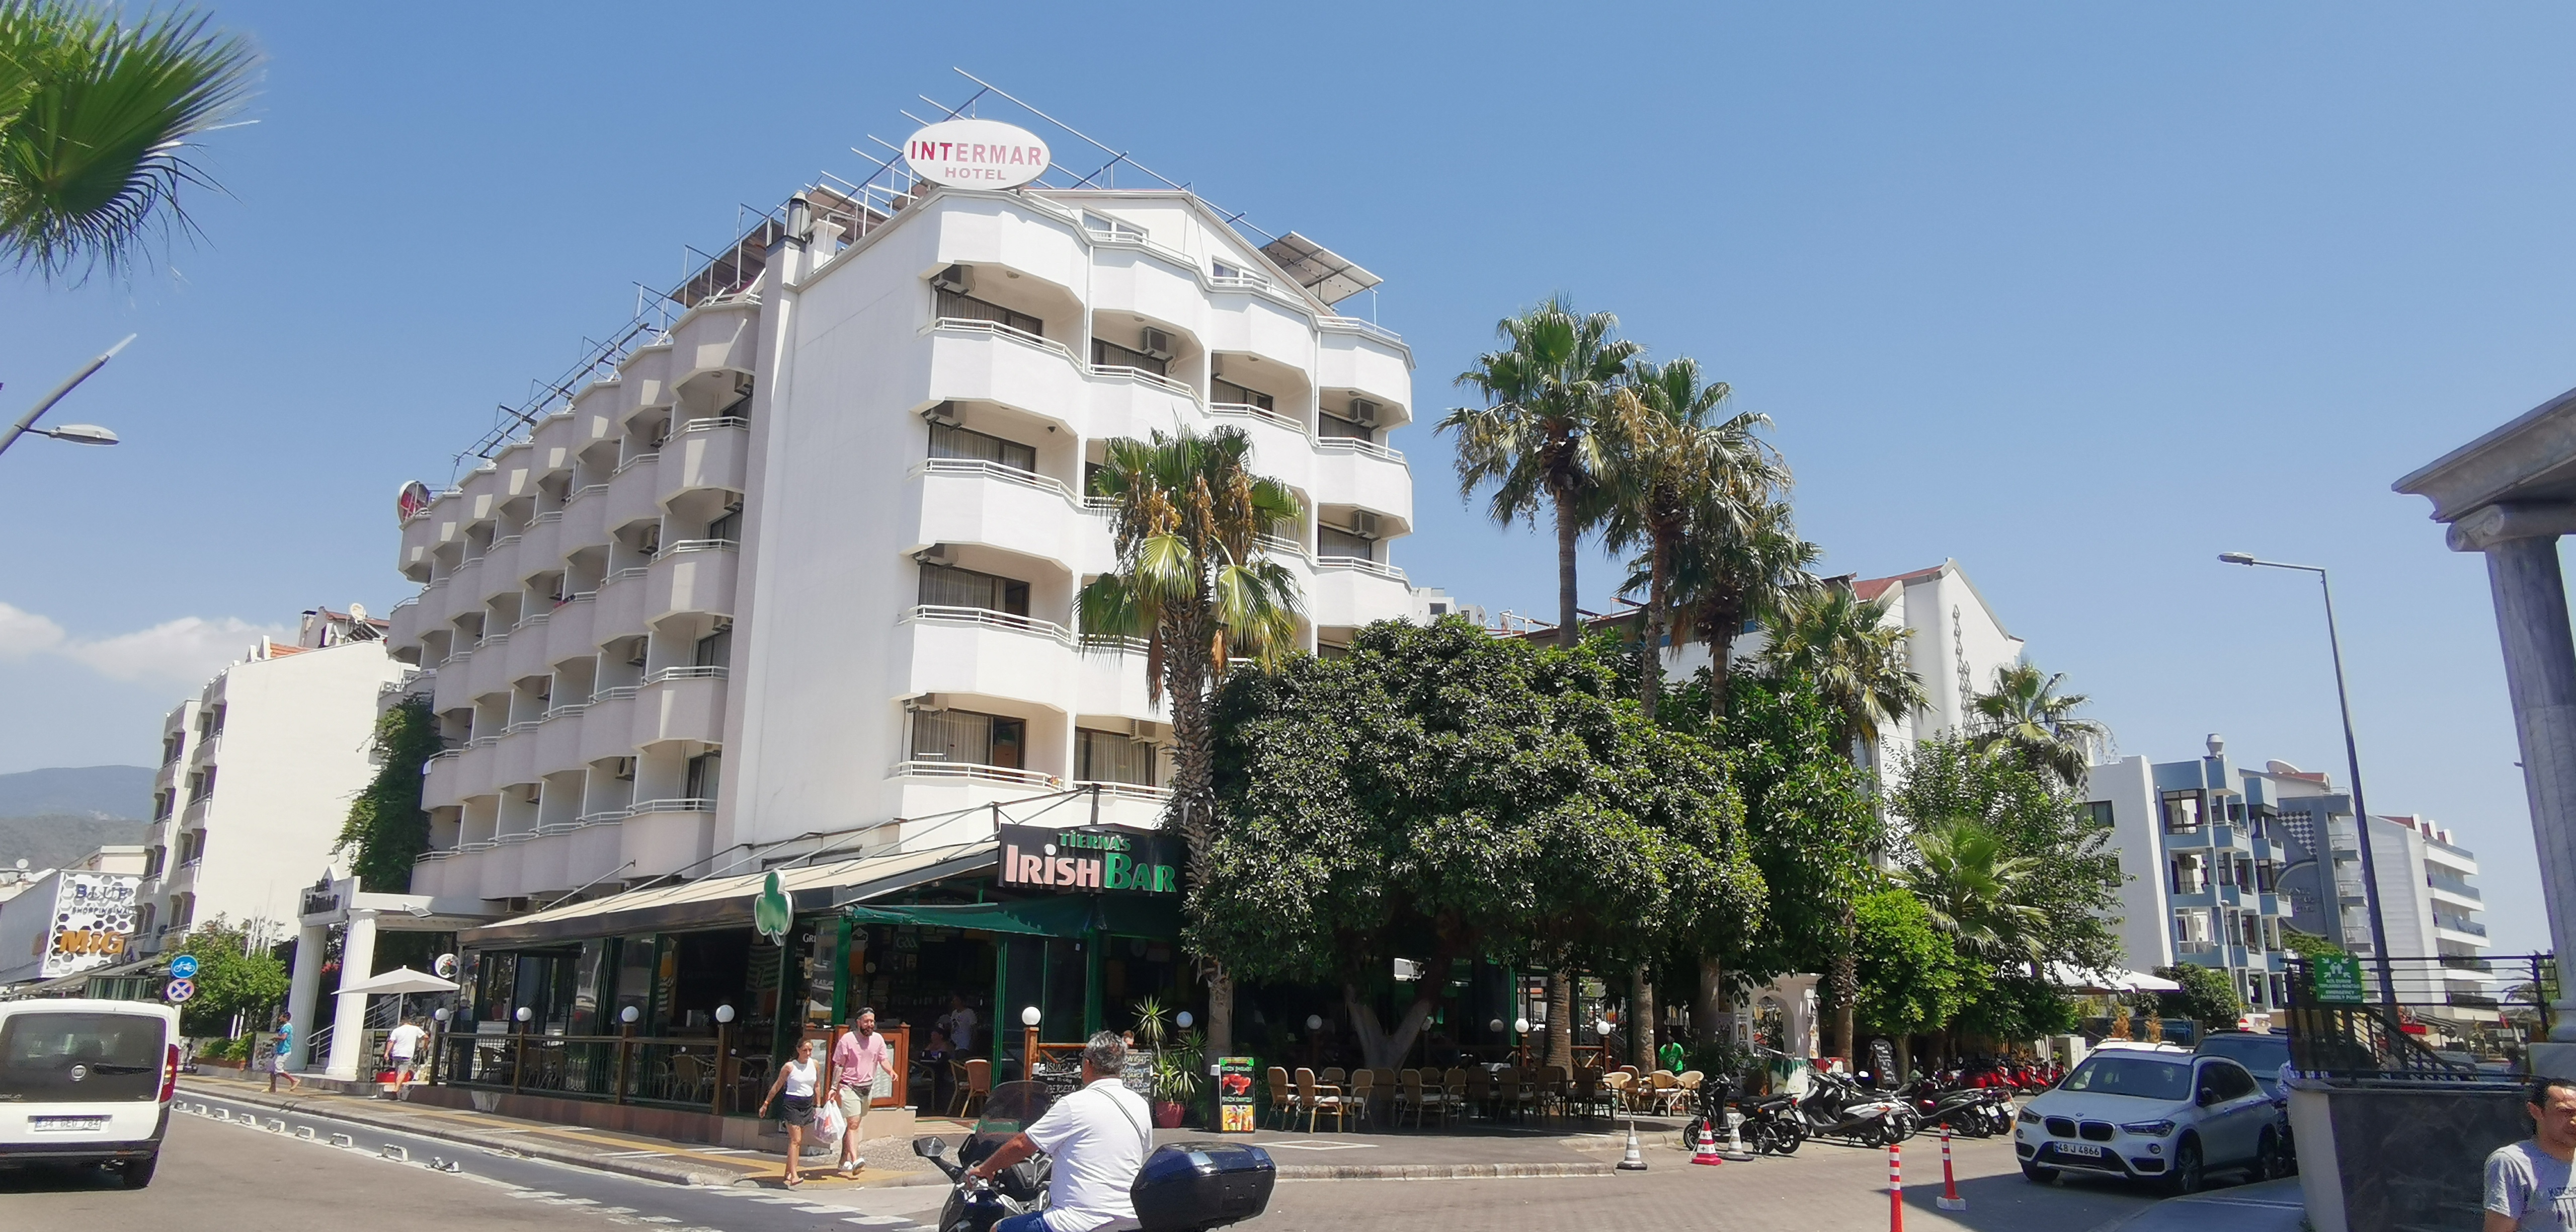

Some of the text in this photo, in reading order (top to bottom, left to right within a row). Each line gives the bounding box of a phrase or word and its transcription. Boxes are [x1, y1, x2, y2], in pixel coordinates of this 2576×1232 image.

[911, 140, 1041, 166] INTERMAR
[945, 167, 1006, 180] HOTEL
[1104, 852, 1177, 893] BAR
[75, 884, 129, 899] BLUE
[71, 906, 113, 915] SHOPPING
[2058, 1143, 2100, 1156] 48 J 4866
